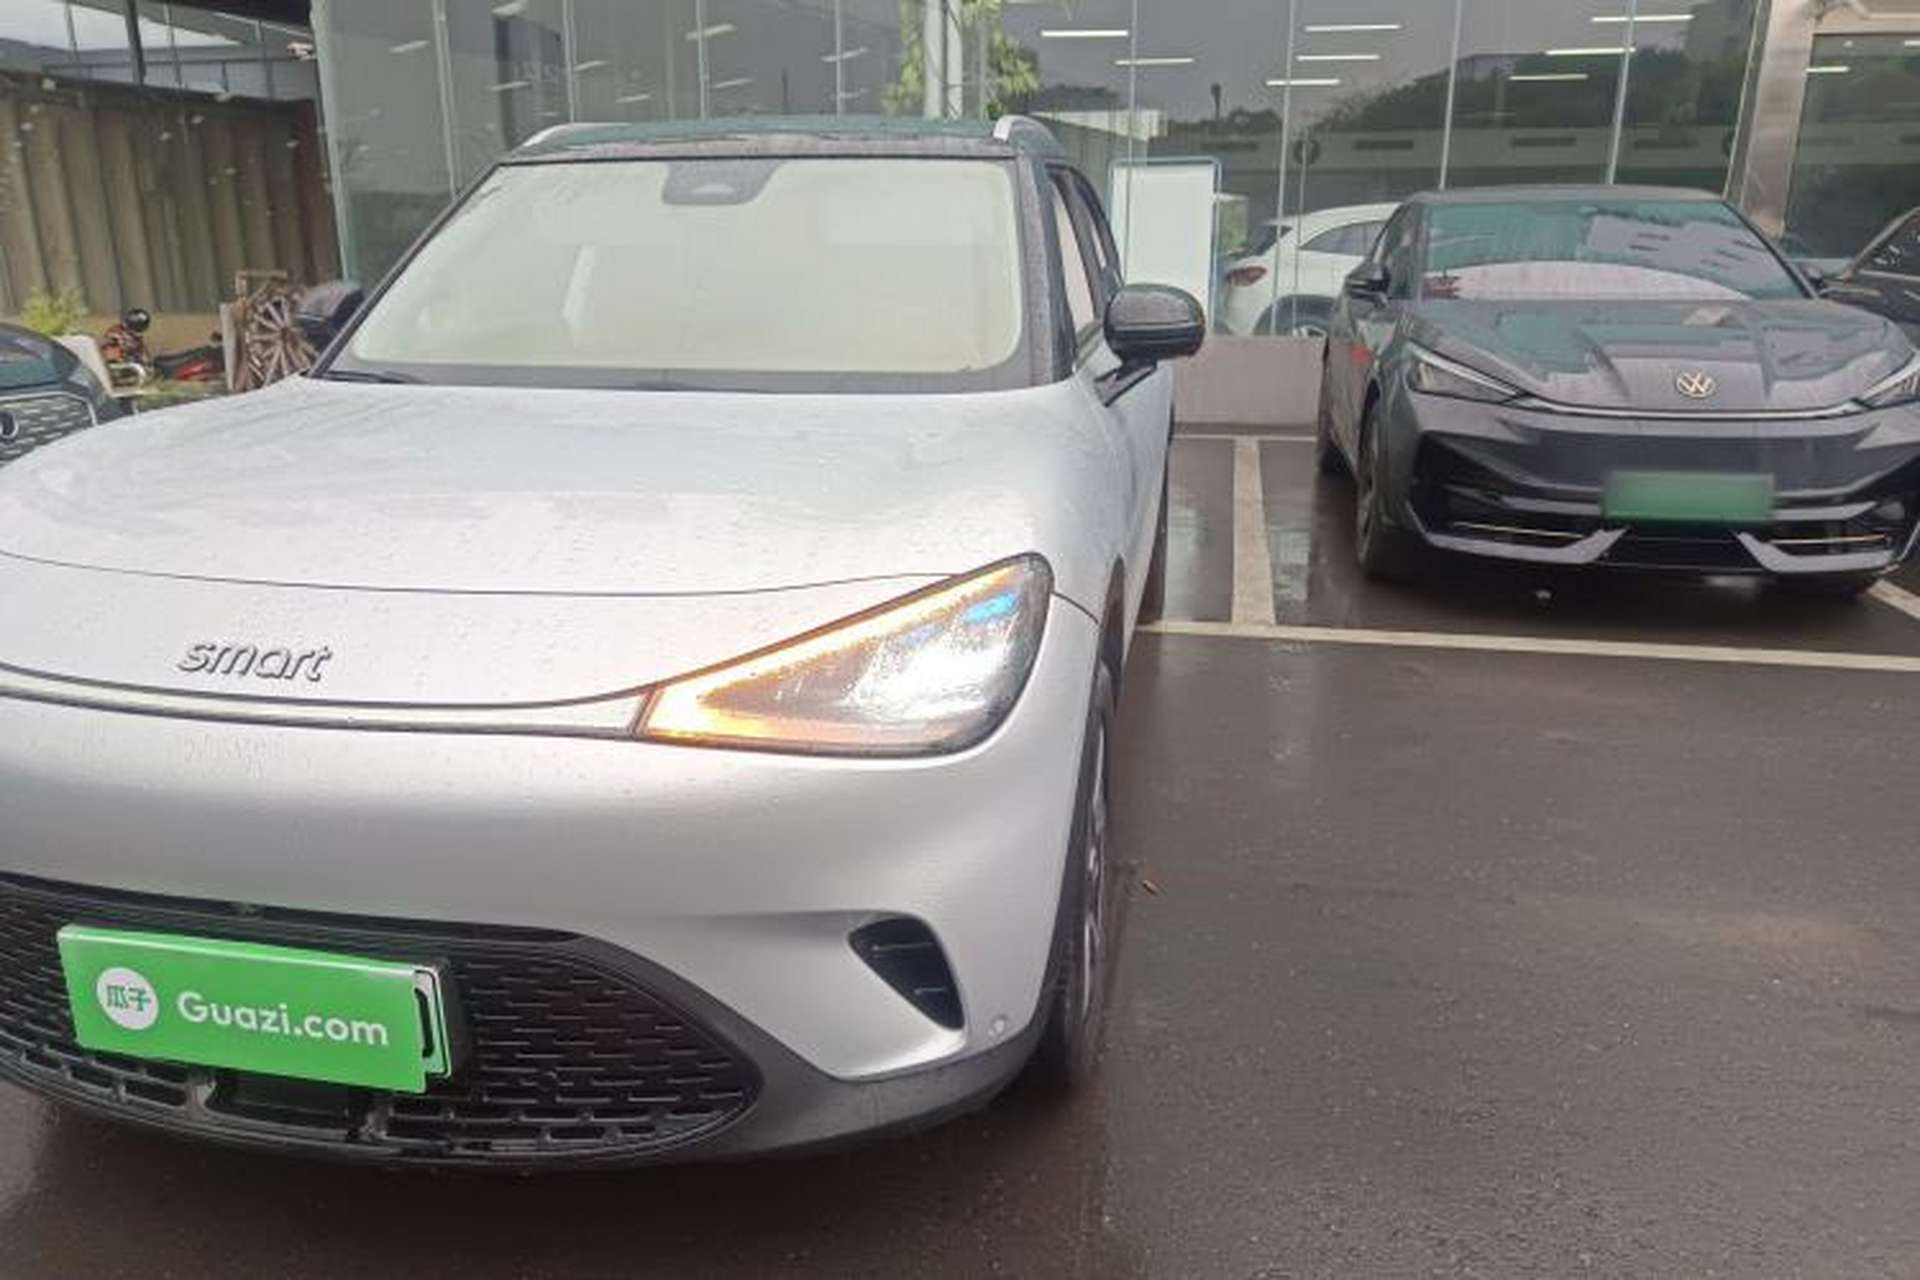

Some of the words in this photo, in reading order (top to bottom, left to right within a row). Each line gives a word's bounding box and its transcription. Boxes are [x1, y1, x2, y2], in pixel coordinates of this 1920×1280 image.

[177, 644, 333, 682] smart
[106, 984, 151, 1012] 瓜子
[176, 990, 390, 1046] Guazi.com
